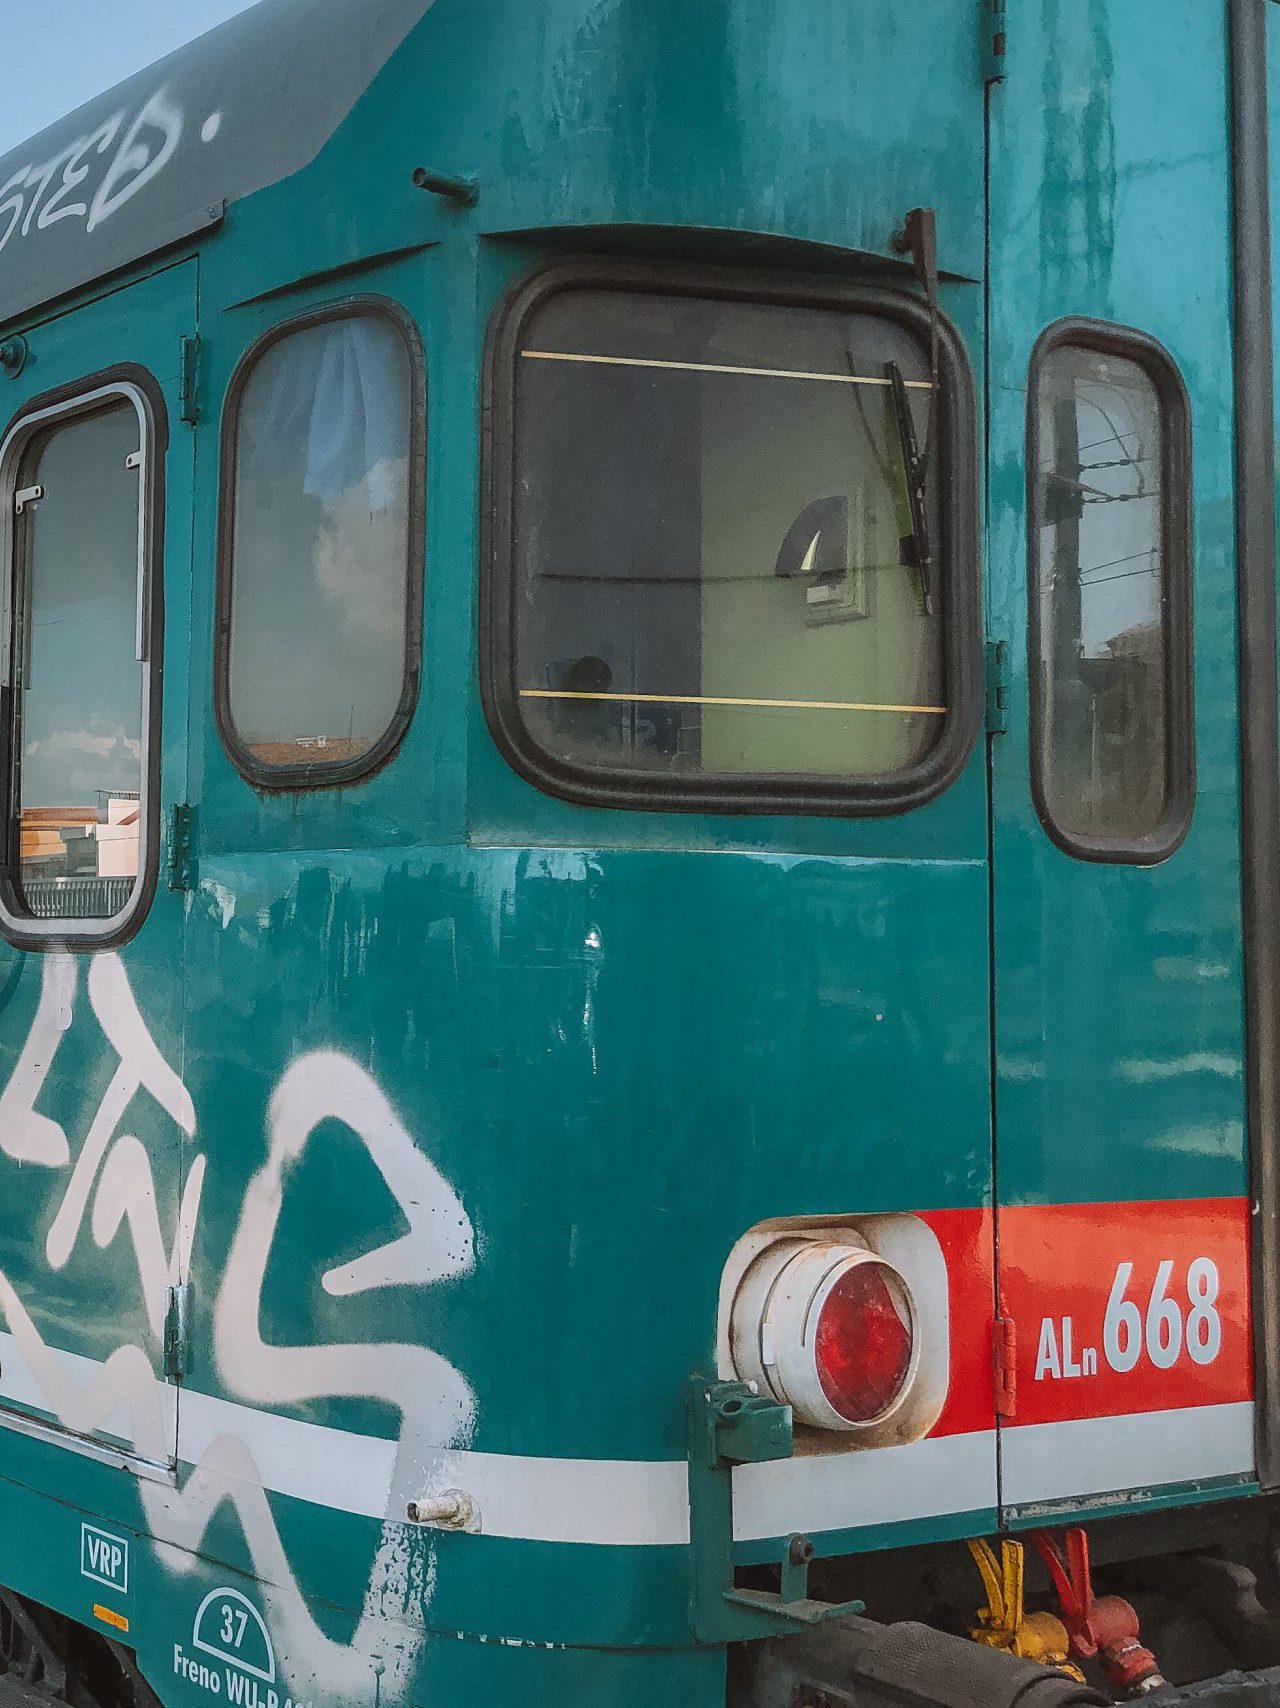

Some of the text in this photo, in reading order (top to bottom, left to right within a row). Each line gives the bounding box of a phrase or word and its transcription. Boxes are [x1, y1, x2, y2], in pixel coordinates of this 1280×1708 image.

[1034, 1256, 1222, 1381] ALn 668
[87, 1534, 122, 1579] VRP
[219, 1603, 249, 1649] 37
[173, 1643, 221, 1694] Freno
